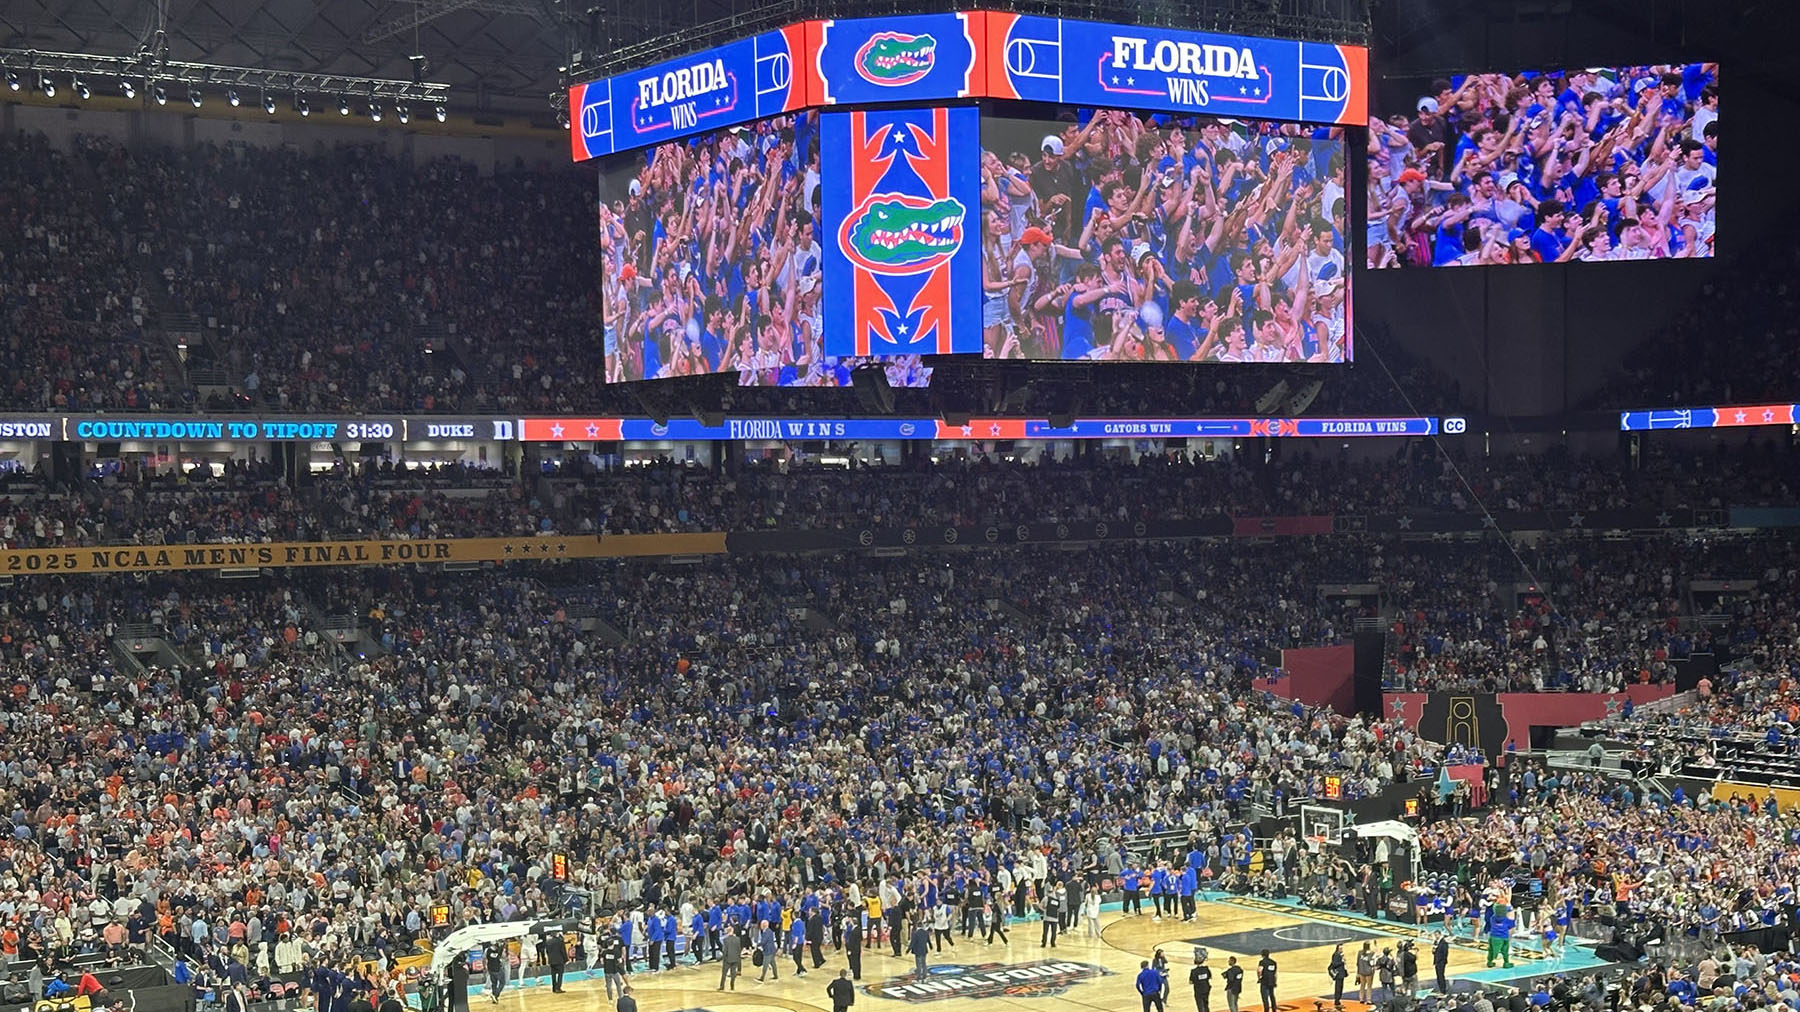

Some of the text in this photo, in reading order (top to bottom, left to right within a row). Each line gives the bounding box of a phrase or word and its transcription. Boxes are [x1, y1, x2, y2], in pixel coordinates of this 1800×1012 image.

[1111, 36, 1260, 80] FLORIDA
[638, 59, 729, 110] FLORIDA
[1166, 77, 1209, 106] WINS
[670, 101, 697, 130] WINS
[0, 423, 51, 437] STON
[77, 422, 394, 438] COUNTDOWN TO TIPOFF 31:30
[428, 424, 474, 437] DUKE
[493, 421, 514, 440] D
[730, 420, 845, 439] FLORIDA WINS
[1104, 423, 1172, 433] GATORS WIN
[1322, 421, 1407, 433] FLORIDA WINS
[1446, 420, 1464, 432] CC
[8, 543, 450, 570] 2025 NCAA MEN'S FINAL FOUR
[880, 962, 1091, 998] FINAL FOUR
